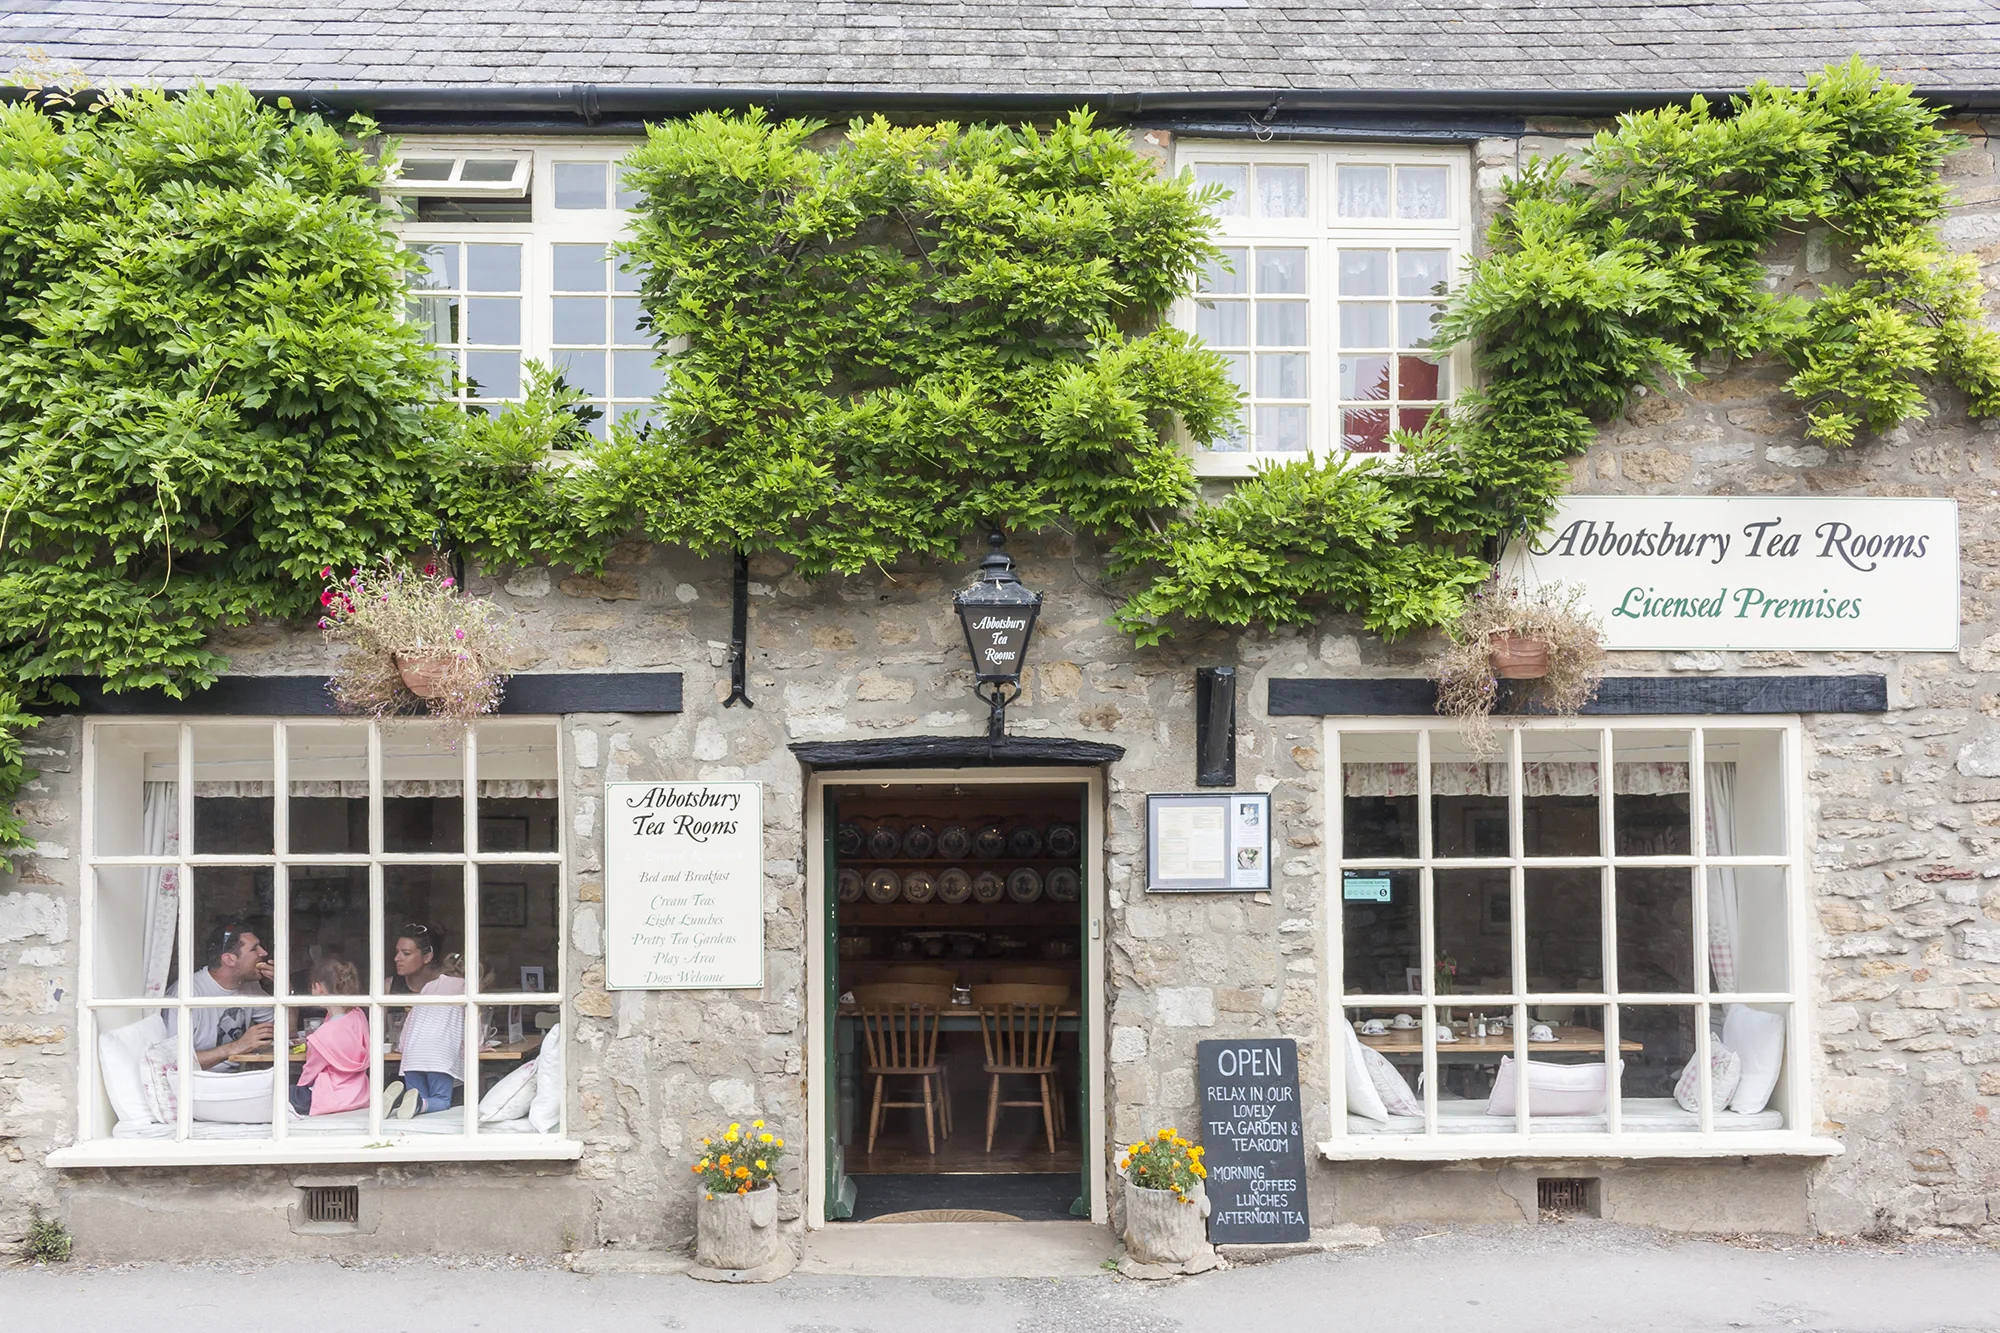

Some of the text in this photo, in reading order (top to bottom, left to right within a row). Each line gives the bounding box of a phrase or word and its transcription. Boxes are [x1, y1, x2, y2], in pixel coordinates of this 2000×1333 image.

[1528, 516, 1930, 572] Abbotsbury Tea Rooms
[1611, 586, 1862, 619] Licensed Premises
[972, 616, 1026, 631] Abbotsbury
[991, 631, 1008, 645] Tea
[984, 647, 1015, 665] Rooms
[626, 787, 741, 811] Abbotsbury
[632, 813, 739, 843] Tea Rooms
[639, 870, 731, 884] Bed and Breakfast
[650, 893, 715, 910] Cream Teas
[644, 913, 724, 927] Light Lunches
[631, 932, 737, 948] Pretty Tea Gardens
[653, 951, 715, 966] Play Area
[644, 970, 725, 985] Dogs Welcome
[1217, 1047, 1282, 1077] OPEN
[1207, 1086, 1293, 1101] RELAX IN OUR
[1233, 1104, 1276, 1122] LOVELY
[1209, 1121, 1299, 1136] TEA GARDEN &
[1232, 1138, 1289, 1152] TEAROOM
[1213, 1165, 1264, 1180] MORNING
[1250, 1179, 1296, 1192] COFFEES
[1236, 1194, 1288, 1207] LUNCHES
[1216, 1211, 1305, 1225] AFTERNOON TEA
